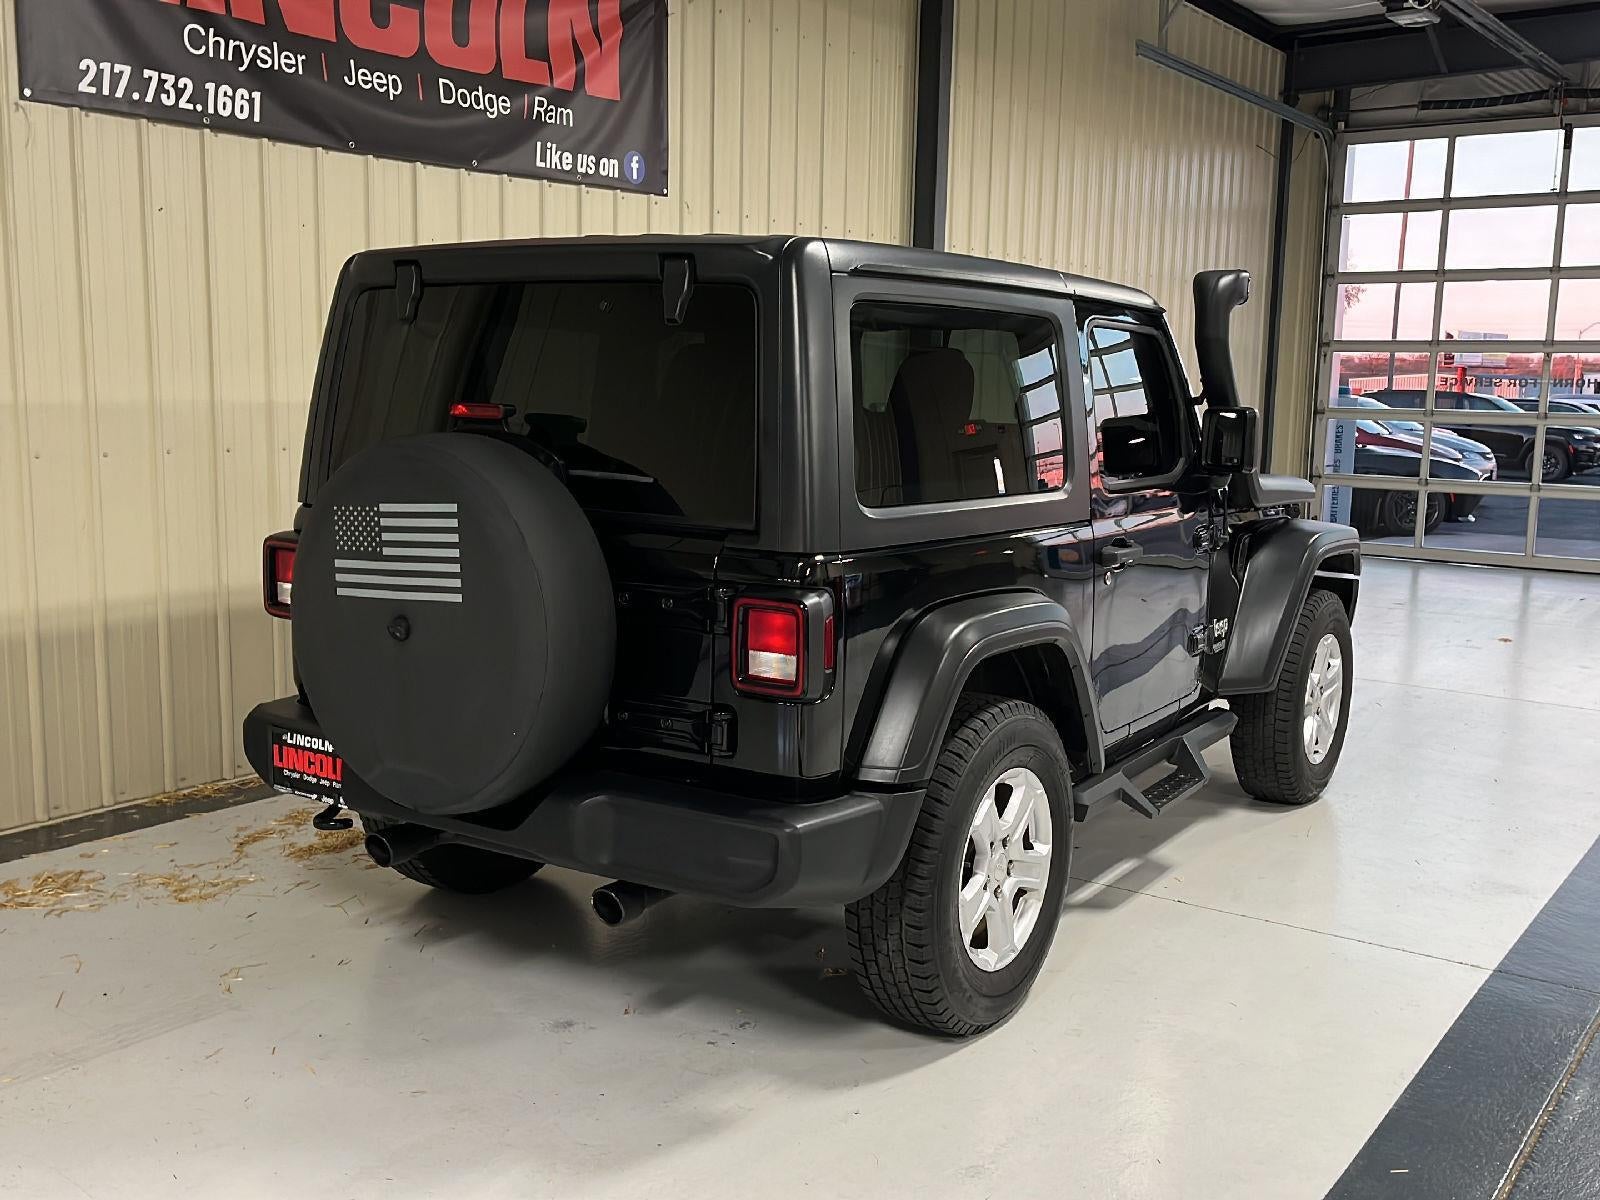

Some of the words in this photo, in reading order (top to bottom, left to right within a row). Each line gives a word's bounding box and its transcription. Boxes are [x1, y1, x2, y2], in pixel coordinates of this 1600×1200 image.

[78, 58, 262, 123] 217.732.1661
[183, 23, 306, 75] Chrysler
[343, 59, 402, 100] Jeep
[438, 78, 511, 119] Dodge
[532, 96, 574, 127] Ram
[536, 141, 573, 173] Like
[577, 152, 596, 175] us
[600, 156, 619, 178] on
[287, 732, 333, 753] LINCOLN
